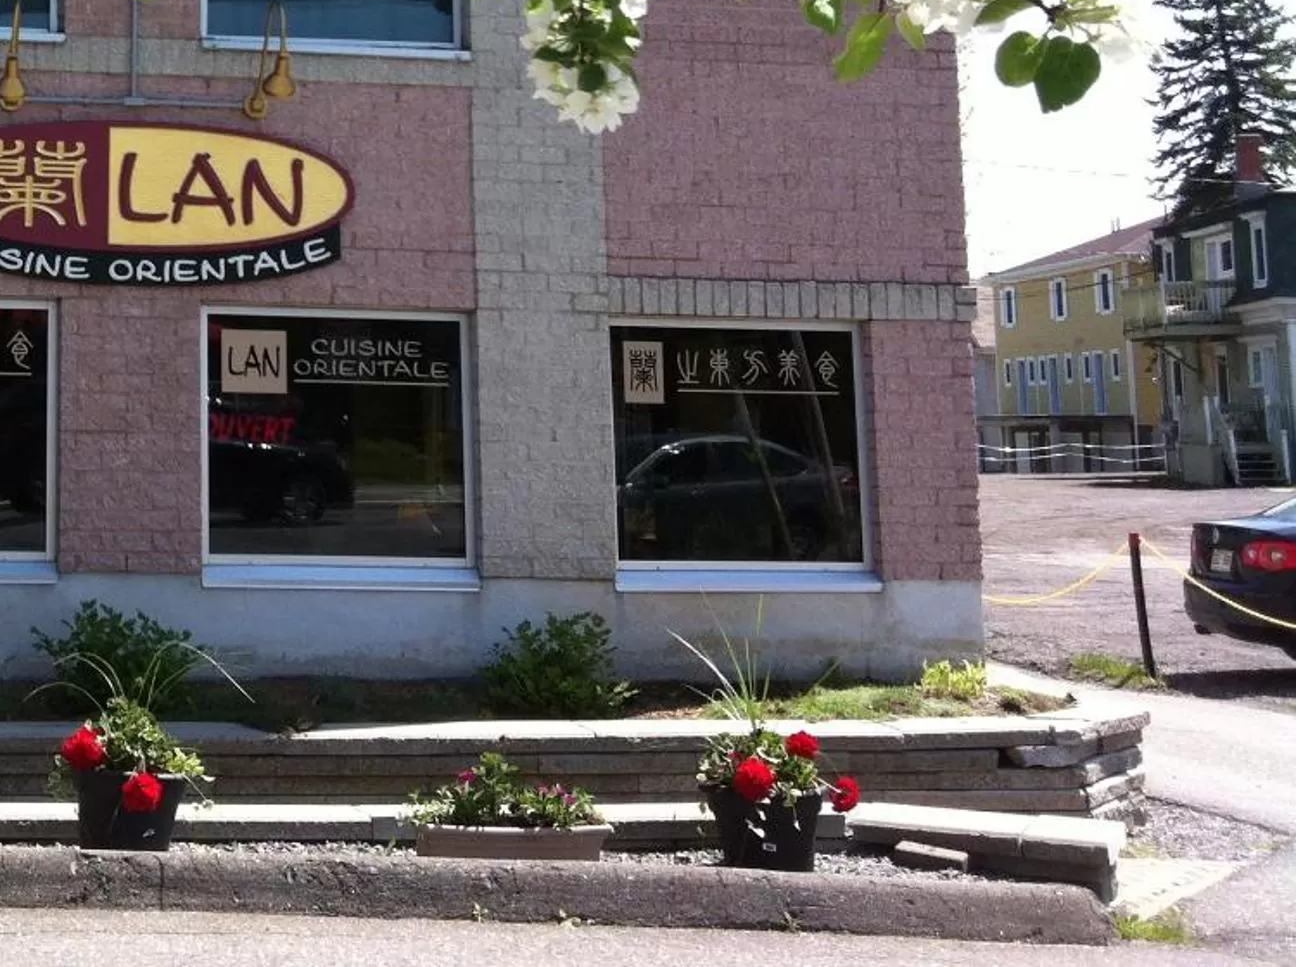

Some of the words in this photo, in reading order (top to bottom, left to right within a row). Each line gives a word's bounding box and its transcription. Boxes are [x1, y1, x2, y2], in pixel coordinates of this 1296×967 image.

[118, 152, 304, 226] LAN
[108, 238, 332, 282] ORIENTALE
[227, 344, 281, 378] LAN
[311, 338, 423, 358] CUISINE
[293, 358, 450, 379] ORIENTALE
